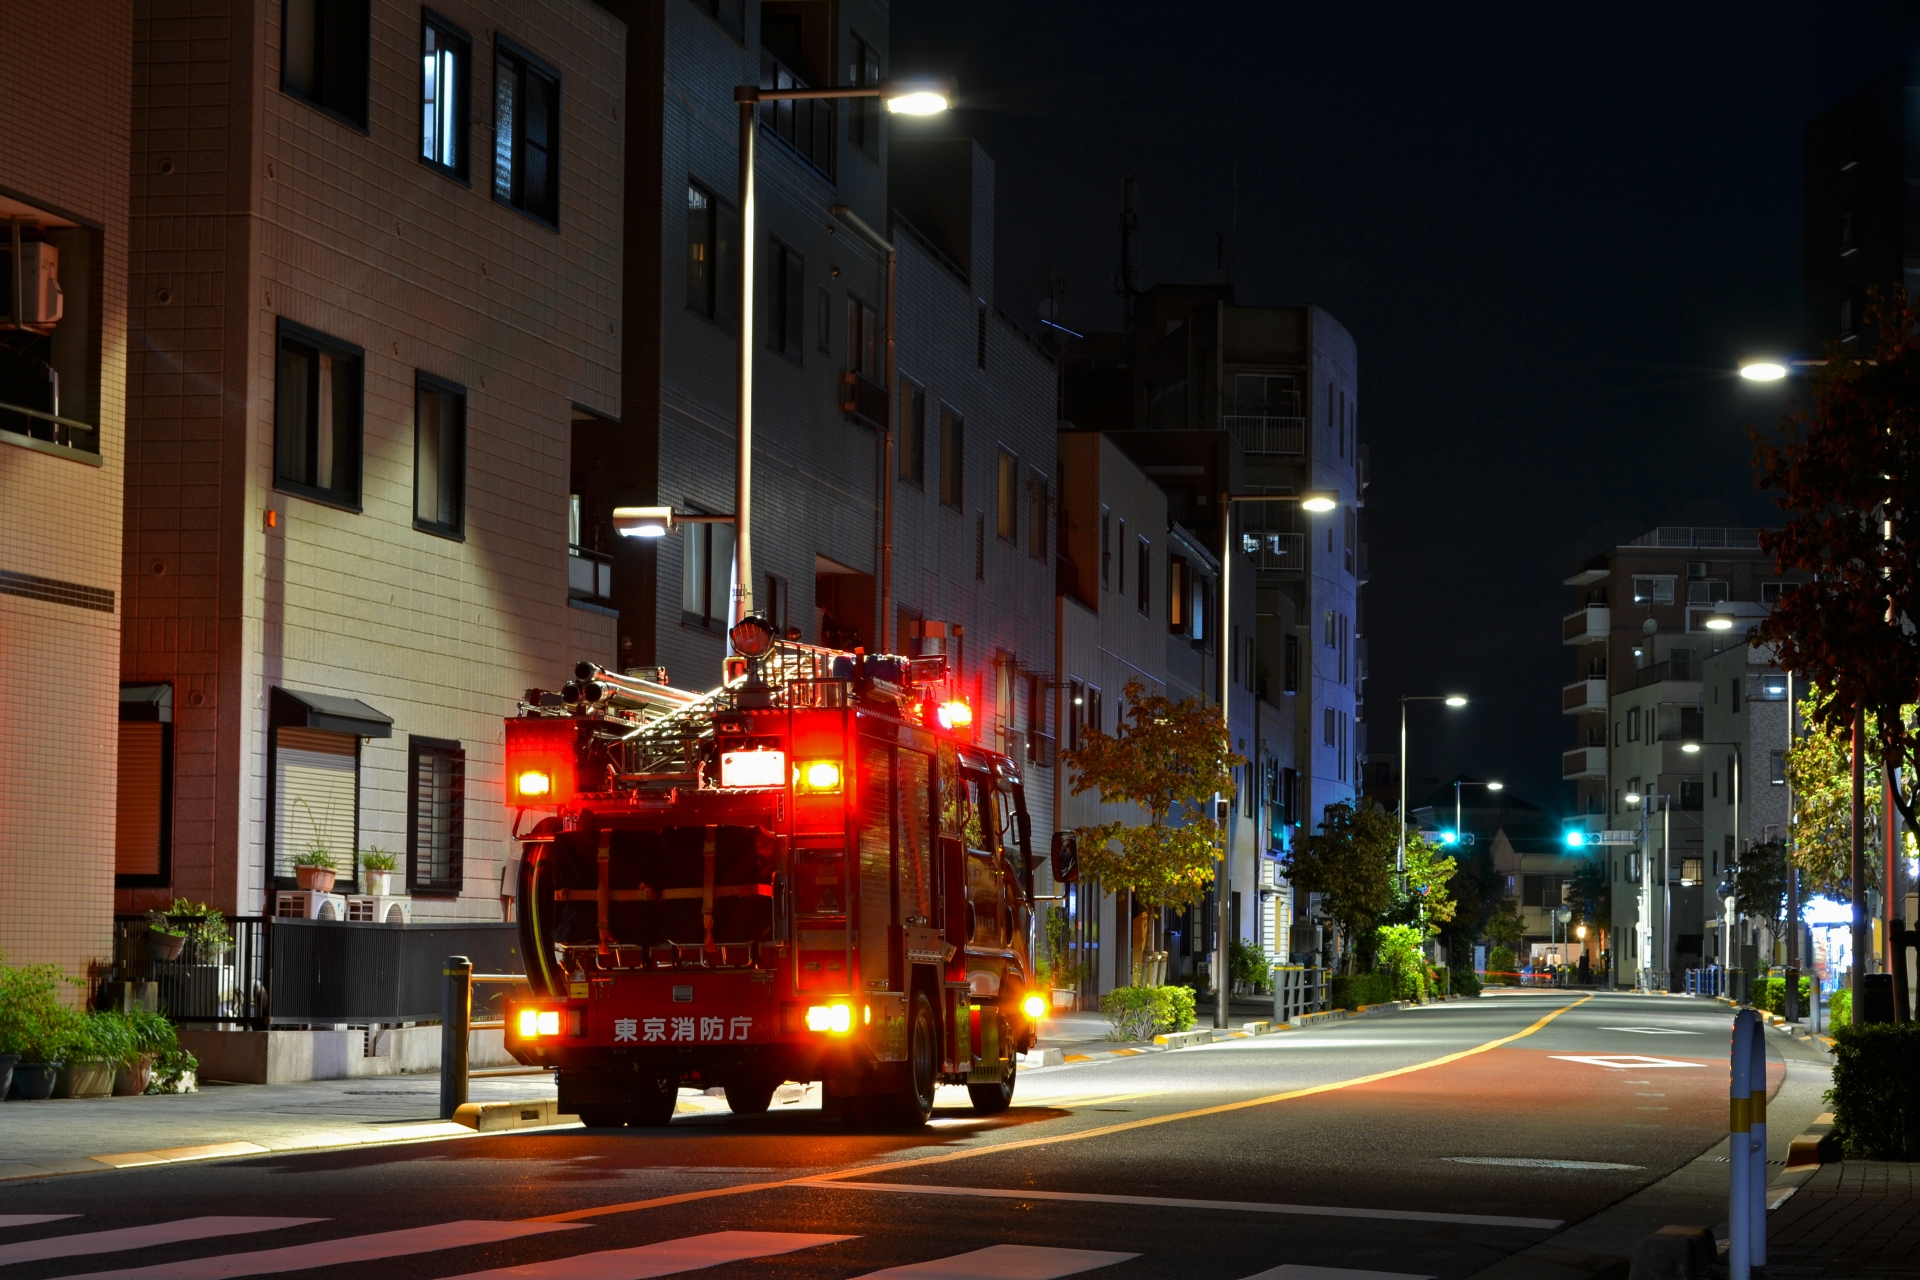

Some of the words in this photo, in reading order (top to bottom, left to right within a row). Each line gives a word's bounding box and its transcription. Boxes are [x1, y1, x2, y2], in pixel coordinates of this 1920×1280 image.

[614, 1016, 752, 1042] 東京消防庁
